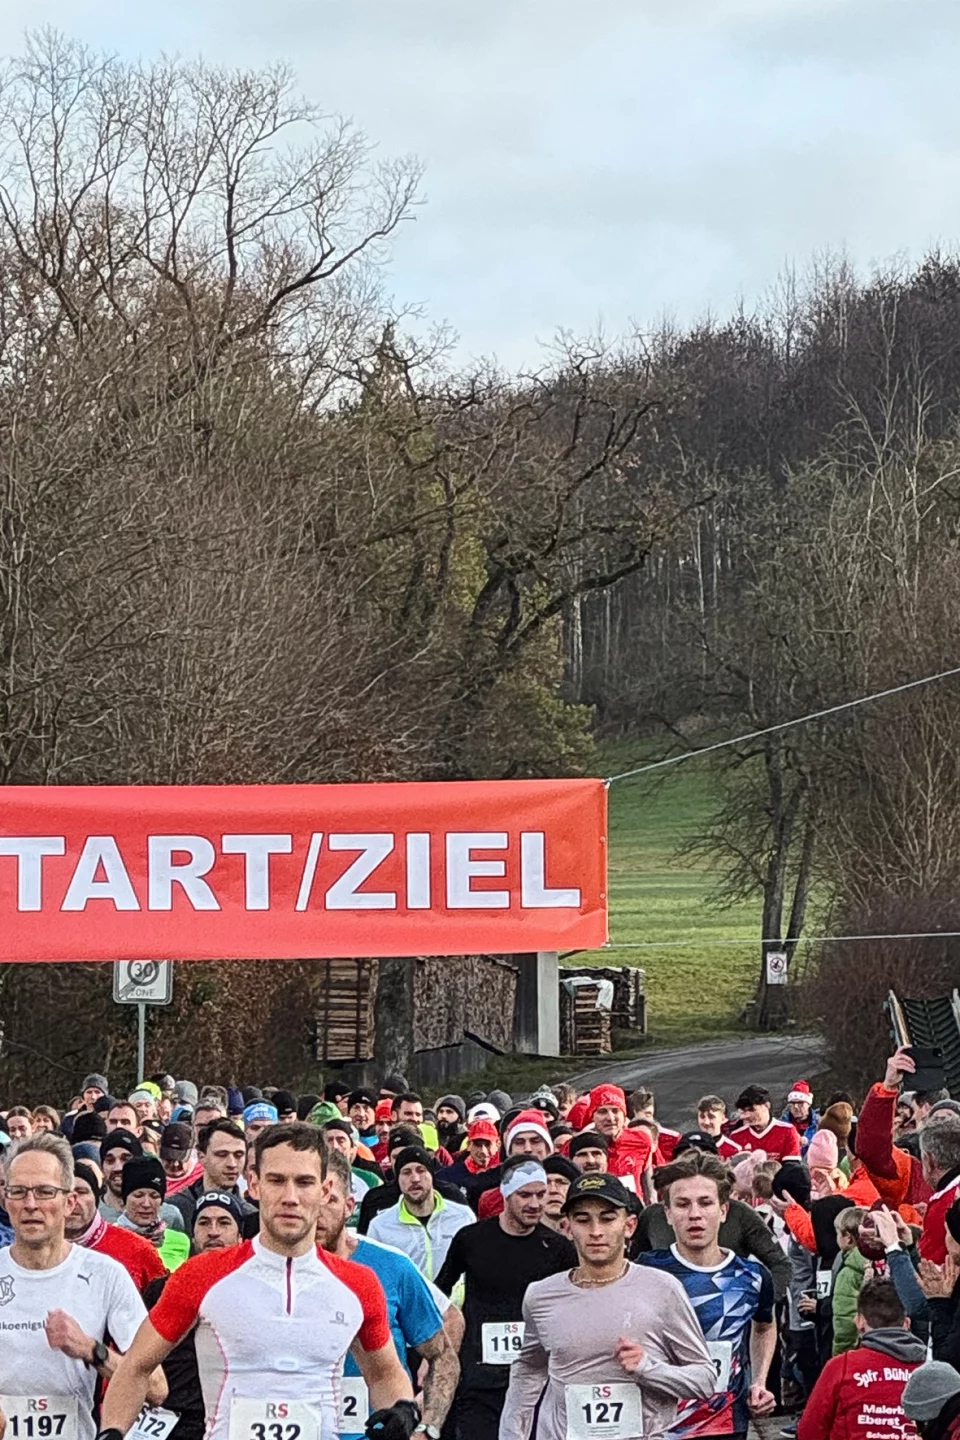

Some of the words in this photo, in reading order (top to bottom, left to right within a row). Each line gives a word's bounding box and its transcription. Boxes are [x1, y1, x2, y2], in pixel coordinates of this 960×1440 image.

[134, 962, 153, 978] 30
[504, 1324, 519, 1334] RS
[591, 1386, 612, 1399] RS
[27, 1398, 48, 1411] RS
[266, 1402, 289, 1419] RS
[581, 1402, 624, 1424] 127
[9, 1414, 67, 1437] 1197
[866, 1431, 900, 1440] Scharfe
